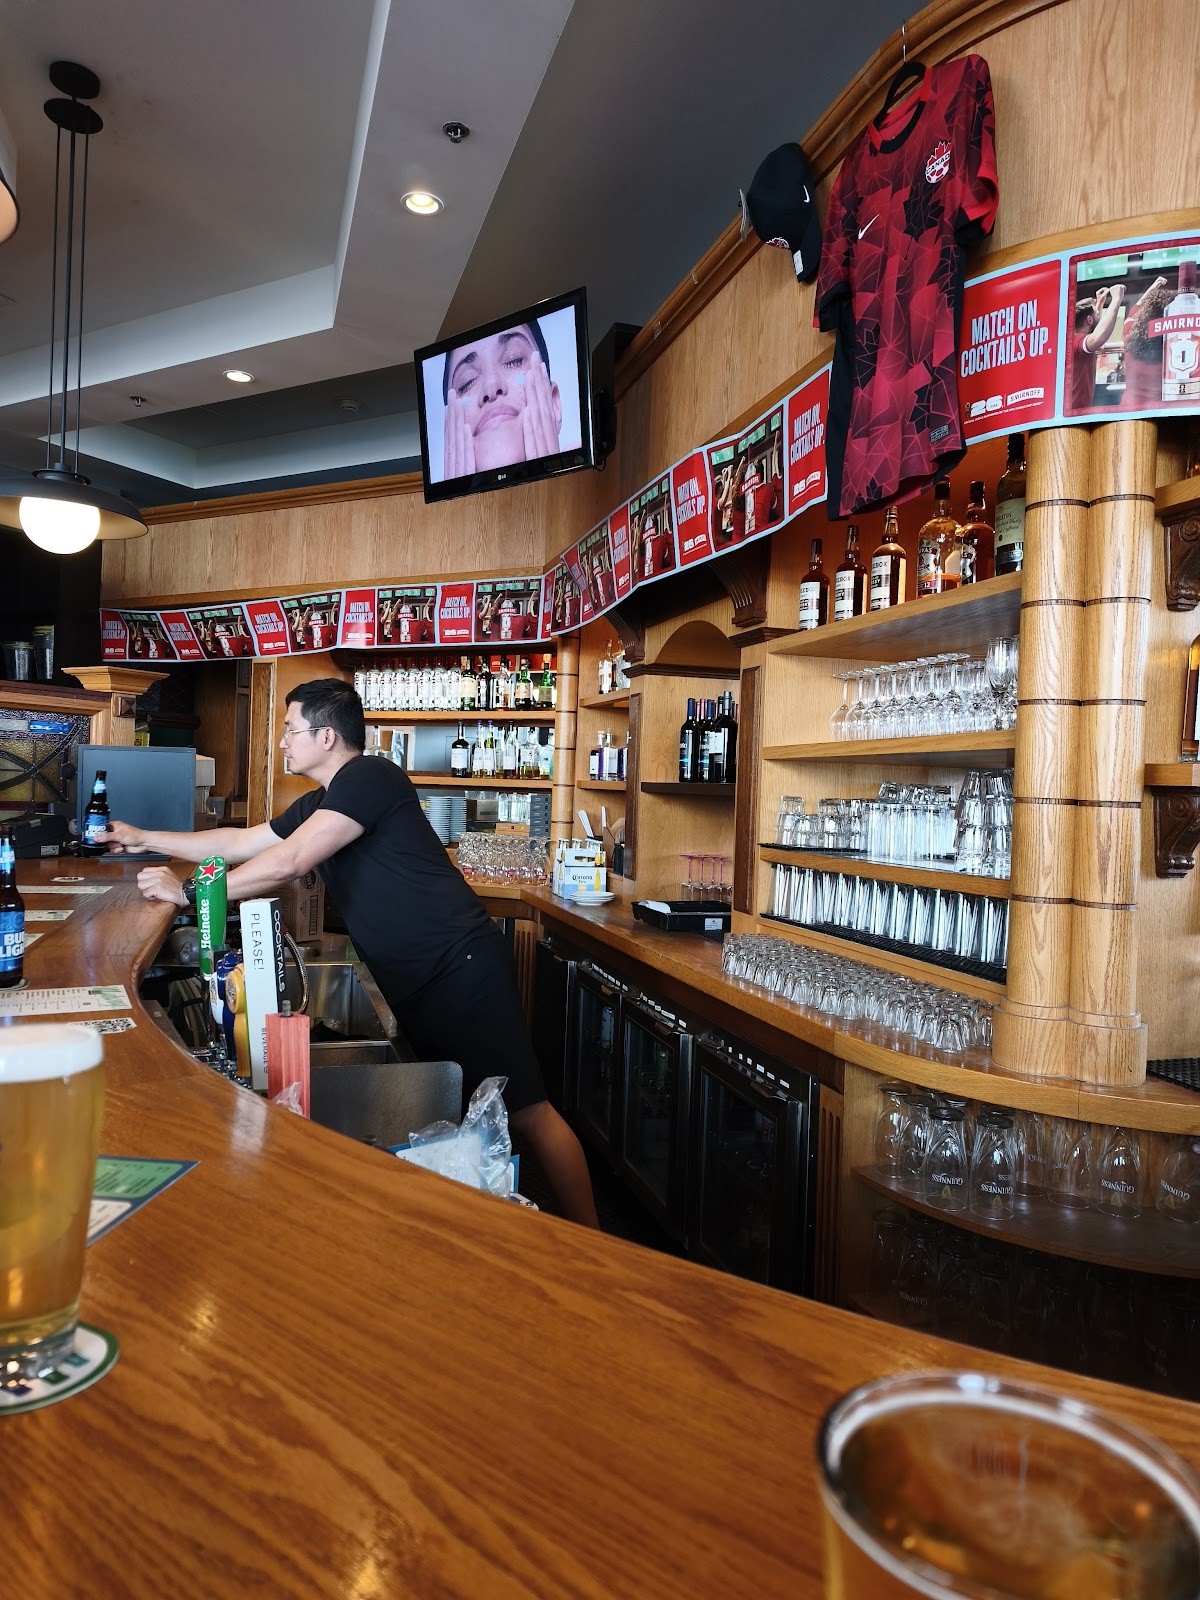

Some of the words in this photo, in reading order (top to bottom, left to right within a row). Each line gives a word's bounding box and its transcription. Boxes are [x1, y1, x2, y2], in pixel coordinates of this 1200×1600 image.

[925, 151, 950, 175] CANAD
[972, 306, 1014, 345] MATCH
[1018, 299, 1040, 331] ON.
[961, 332, 1026, 378] COCKTAILS
[1029, 327, 1052, 357] UP.
[971, 395, 1004, 417] 26
[200, 897, 211, 950] Heineke
[4, 931, 25, 946] BU
[250, 913, 264, 970] PLEASE!
[0, 943, 24, 958] LIGH
[274, 910, 285, 992] COCKTAILS
[931, 1174, 963, 1186] GUINNESS
[981, 1183, 1013, 1194] GUINNESS
[1101, 1179, 1135, 1194] GUINNESS
